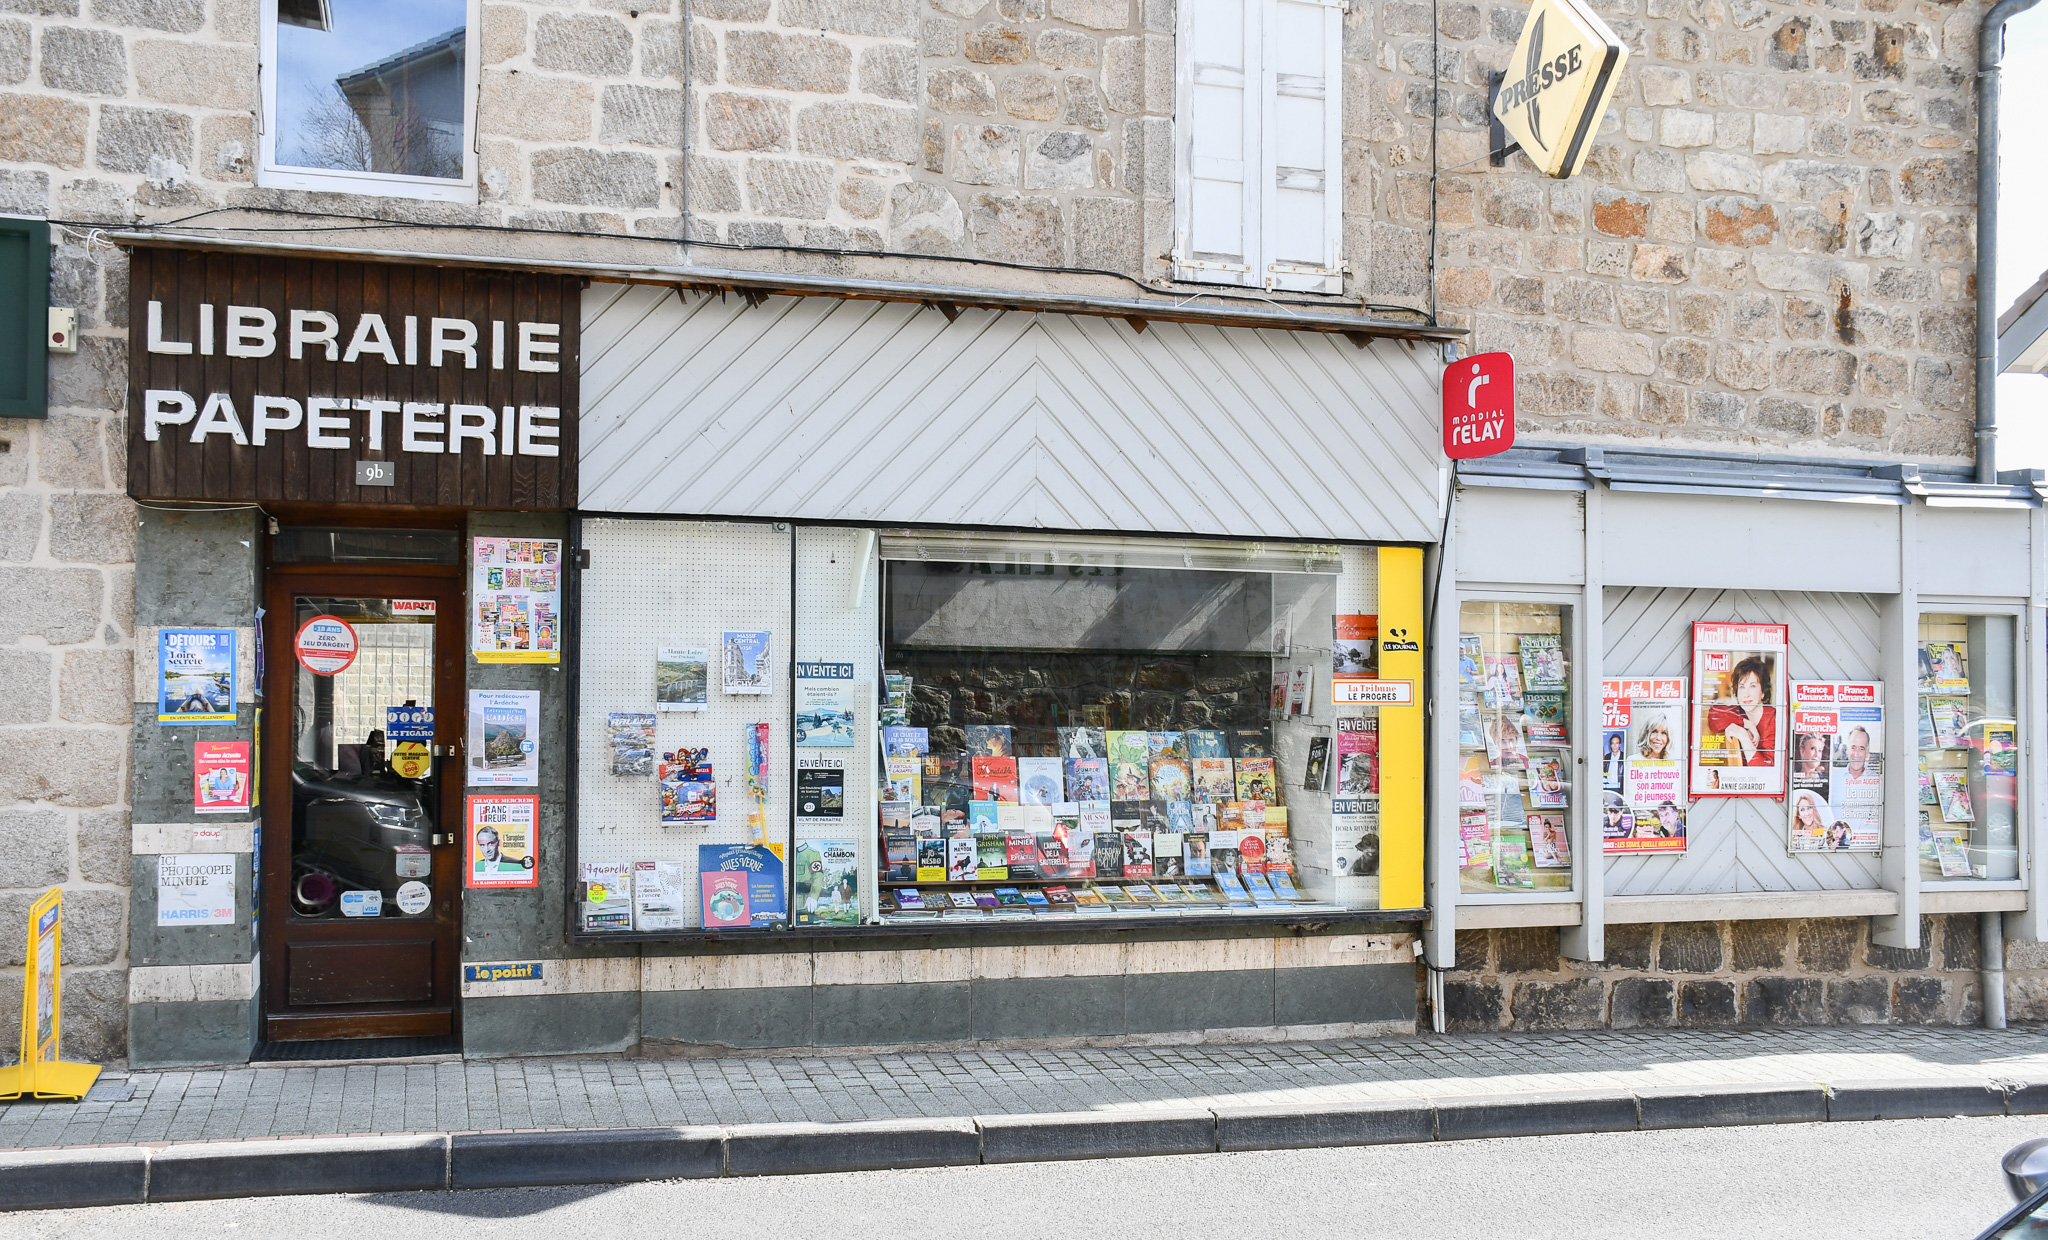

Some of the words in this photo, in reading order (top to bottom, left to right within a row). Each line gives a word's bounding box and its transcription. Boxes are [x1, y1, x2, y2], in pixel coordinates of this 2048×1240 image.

[1501, 44, 1582, 116] PRESSE
[148, 300, 560, 373] LIBRAIRIE
[144, 389, 560, 457] PAPETERIE
[366, 464, 384, 480] 9b
[170, 634, 216, 646] DÉTOURS
[1705, 654, 1729, 671] MATCH
[806, 665, 837, 677] VENTE
[840, 665, 851, 677] ICI
[1348, 684, 1358, 692] La
[1360, 684, 1396, 692] Tribune
[1655, 688, 1679, 697] Paris
[1803, 686, 1828, 694] France
[1844, 686, 1869, 694] France
[1348, 693, 1358, 701] LE
[1526, 694, 1561, 702] nexus
[1624, 689, 1649, 698] Paris
[1798, 693, 1834, 701] Dimanche
[1839, 694, 1874, 702] Dimanche
[1803, 713, 1831, 723] France
[1339, 721, 1350, 730] EN
[1351, 721, 1377, 730] VENTE
[1796, 722, 1836, 732] Dimanche
[800, 760, 809, 768] EN
[810, 760, 832, 768] VENTE
[834, 760, 843, 768] ICI
[1630, 770, 1644, 780] Elle
[1650, 769, 1680, 780] retrouvé
[1650, 782, 1674, 790] amour
[1635, 792, 1643, 801] de
[1644, 792, 1676, 803] jeunesse
[1847, 788, 1859, 798] La
[1860, 788, 1880, 798] mort
[480, 806, 507, 814] FRANC
[1334, 802, 1345, 812] EN
[1346, 802, 1372, 812] VENTE
[480, 814, 507, 822] TIREUR
[1047, 850, 1054, 858] DE
[161, 856, 177, 865] ICI
[720, 858, 740, 872] JULES
[740, 857, 764, 872] VERNE
[1040, 858, 1068, 866] SAUTERELLE
[161, 865, 233, 876] PHOTOCOPIE
[587, 863, 629, 878] Aquarelle
[161, 876, 209, 887] MINUTE
[475, 966, 490, 979] le
[492, 964, 533, 981] point
